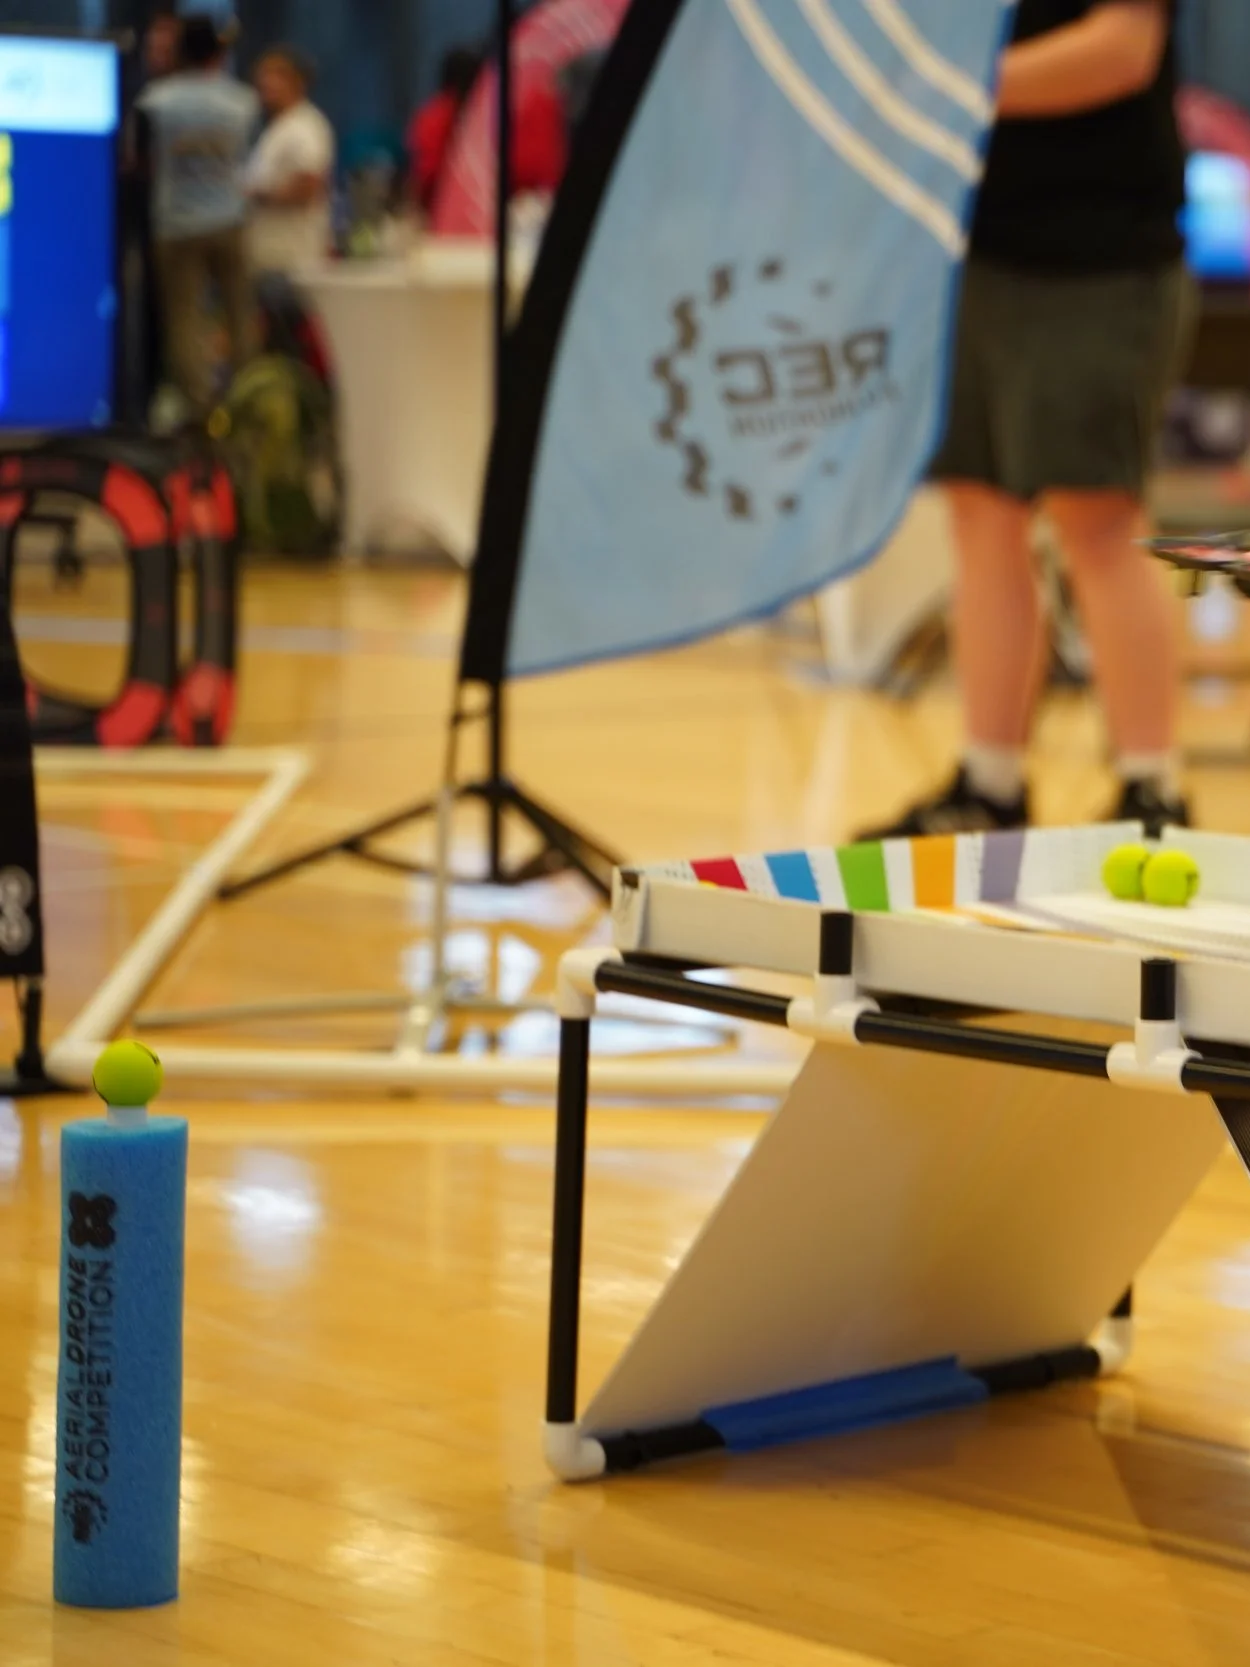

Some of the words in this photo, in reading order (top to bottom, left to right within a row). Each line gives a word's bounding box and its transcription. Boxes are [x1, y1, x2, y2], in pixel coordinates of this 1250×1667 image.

[67, 1254, 87, 1365] DRONE
[65, 1367, 85, 1481] AERIAL
[86, 1260, 113, 1485] COMPETITION
